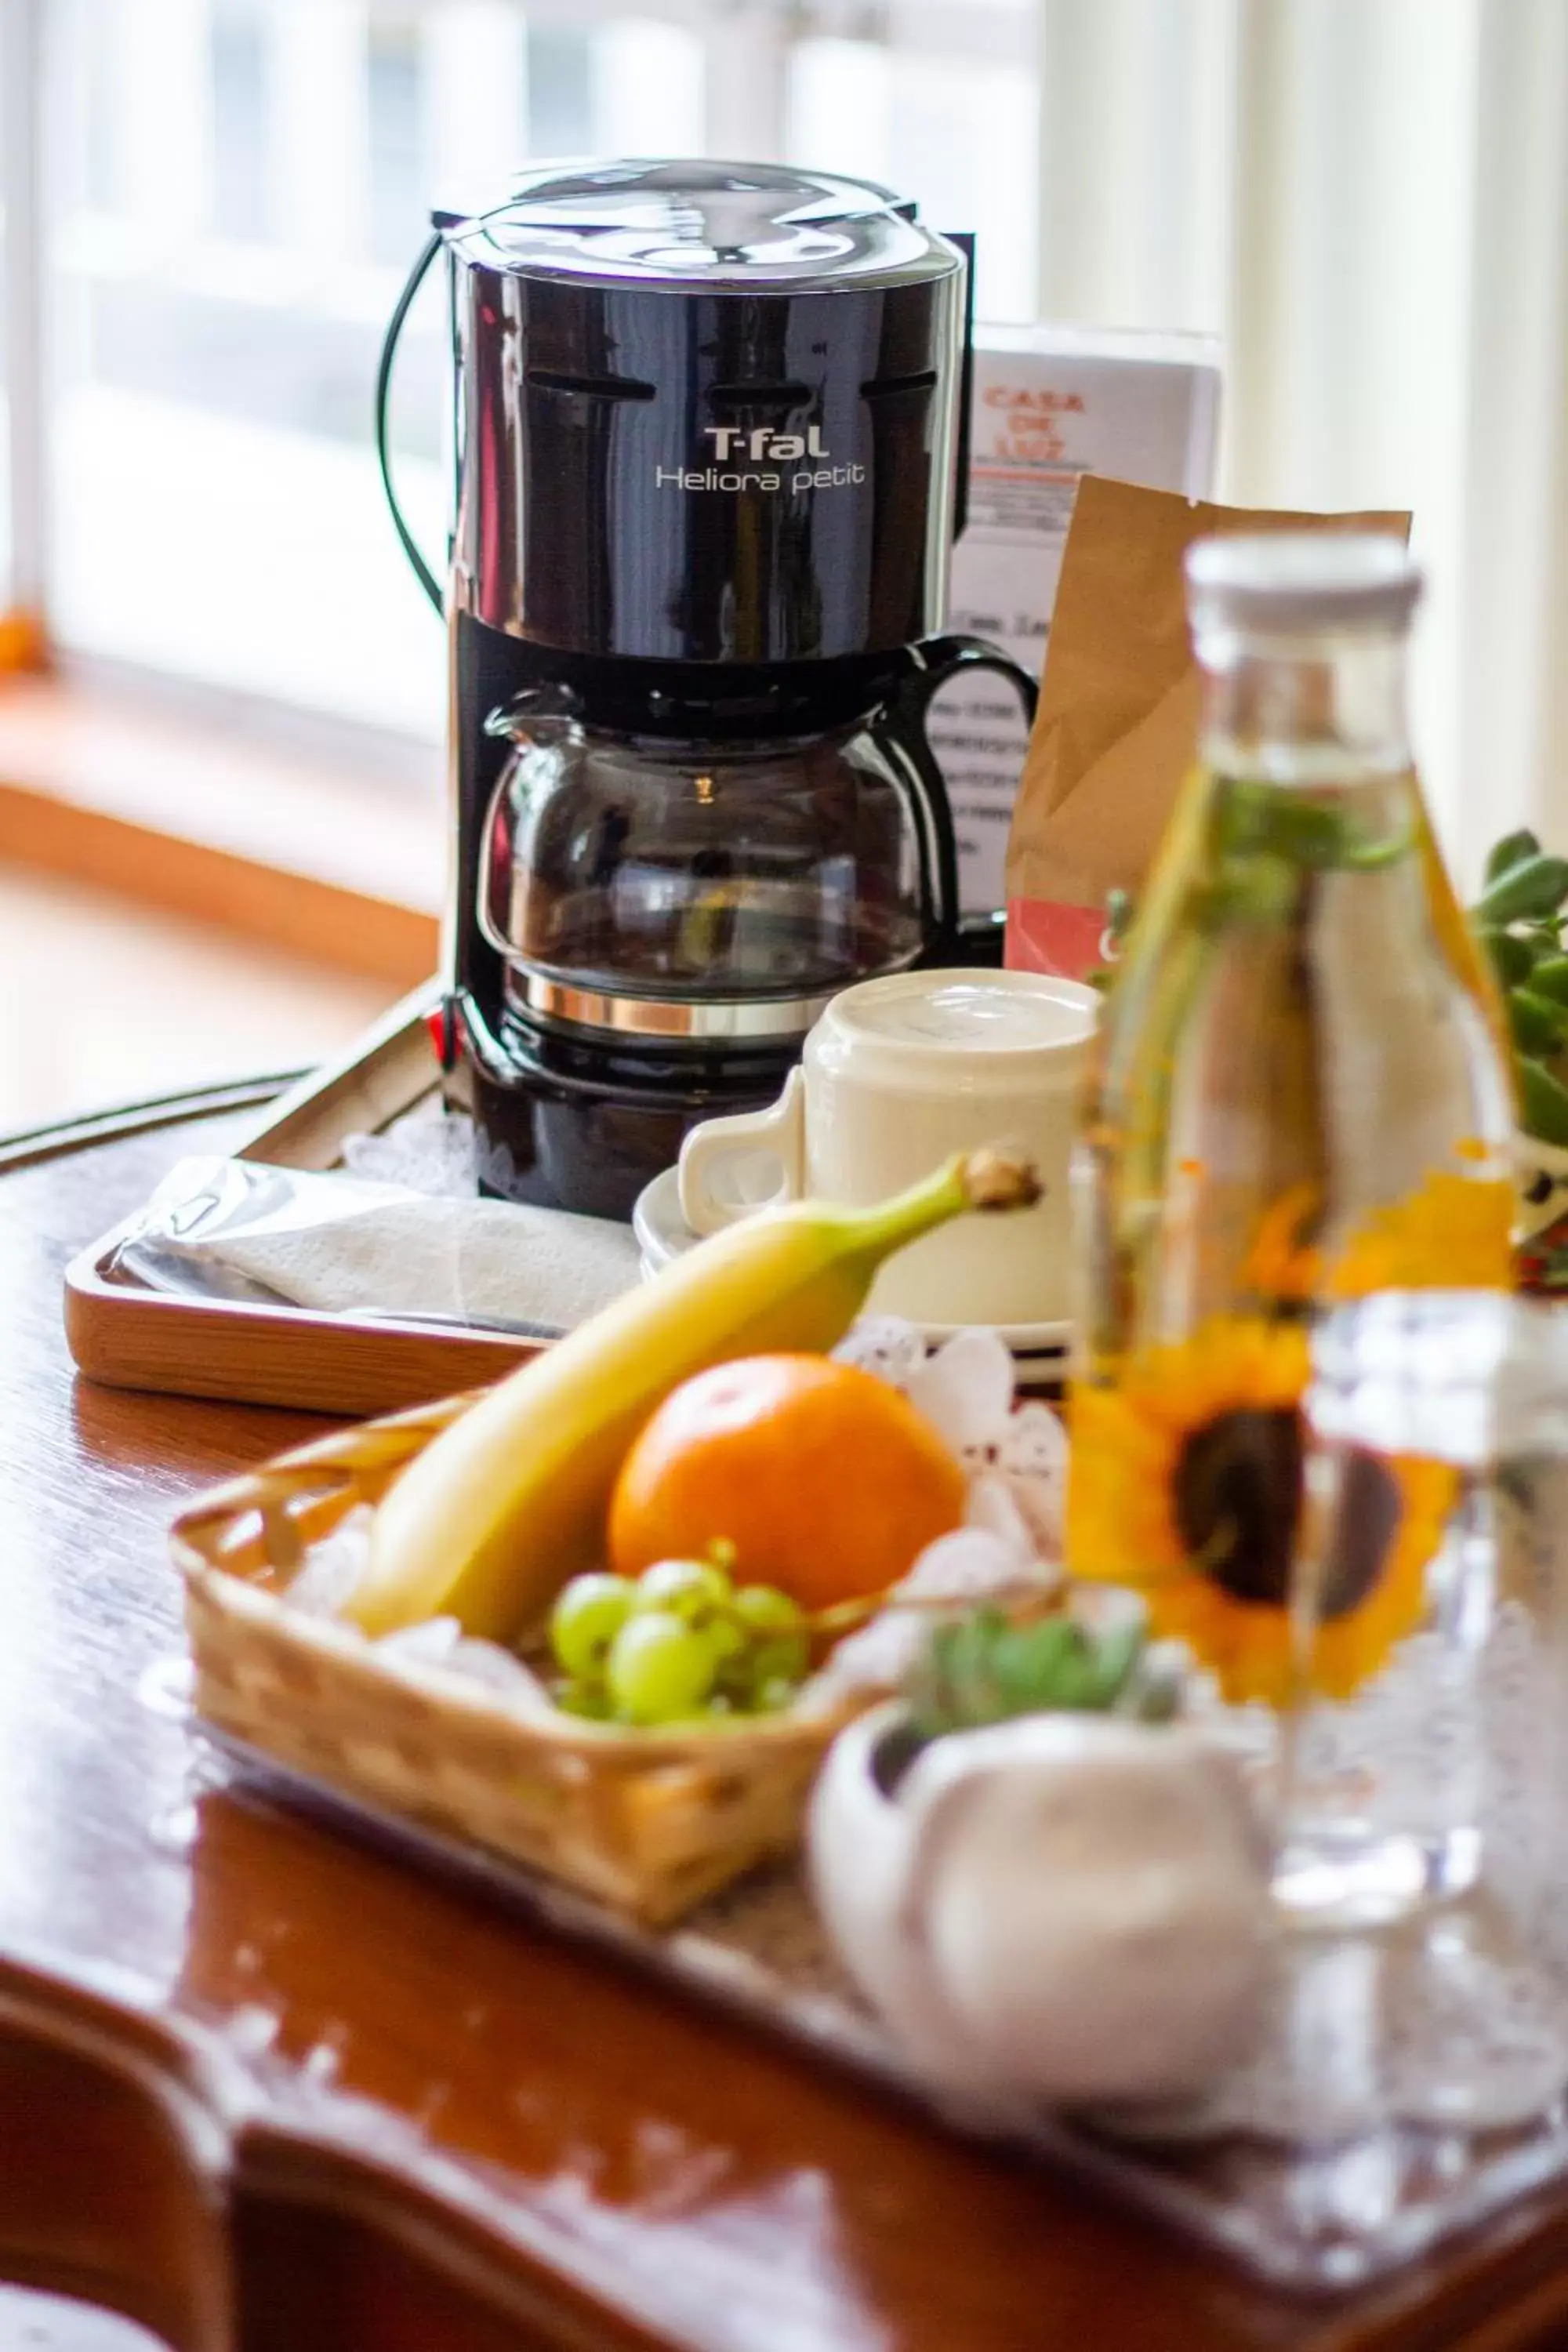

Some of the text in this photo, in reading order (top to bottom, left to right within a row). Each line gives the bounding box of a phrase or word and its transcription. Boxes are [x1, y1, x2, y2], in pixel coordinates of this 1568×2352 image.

[982, 387, 1085, 413] CASA
[1007, 414, 1053, 434] DE
[704, 426, 830, 461] T-fal
[994, 436, 1065, 461] LUZ
[655, 463, 866, 496] Heliora petit
